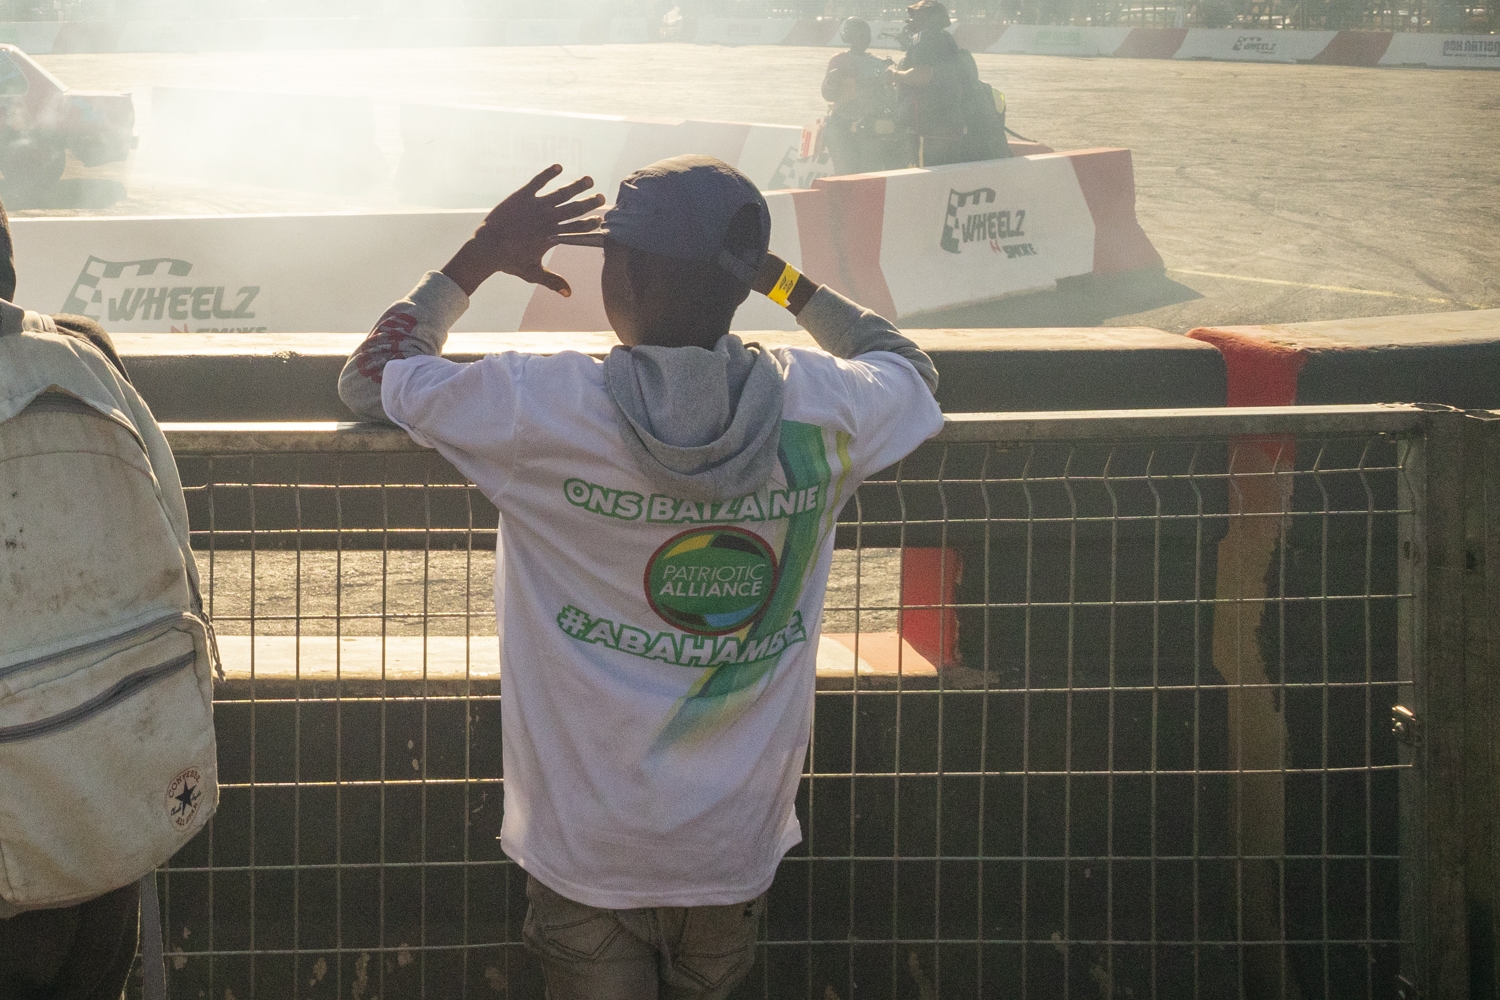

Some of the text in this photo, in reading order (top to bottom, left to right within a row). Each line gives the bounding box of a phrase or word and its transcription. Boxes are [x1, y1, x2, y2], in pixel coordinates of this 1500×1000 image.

[961, 210, 1026, 243] WHEELZ
[108, 285, 261, 322] WHEELZ
[563, 478, 644, 521] ONS
[768, 485, 821, 521] NIE
[659, 580, 764, 598] ALLIANCE
[662, 563, 767, 582] PATRIOTIC
[556, 604, 807, 668] #ABAHAMBE
